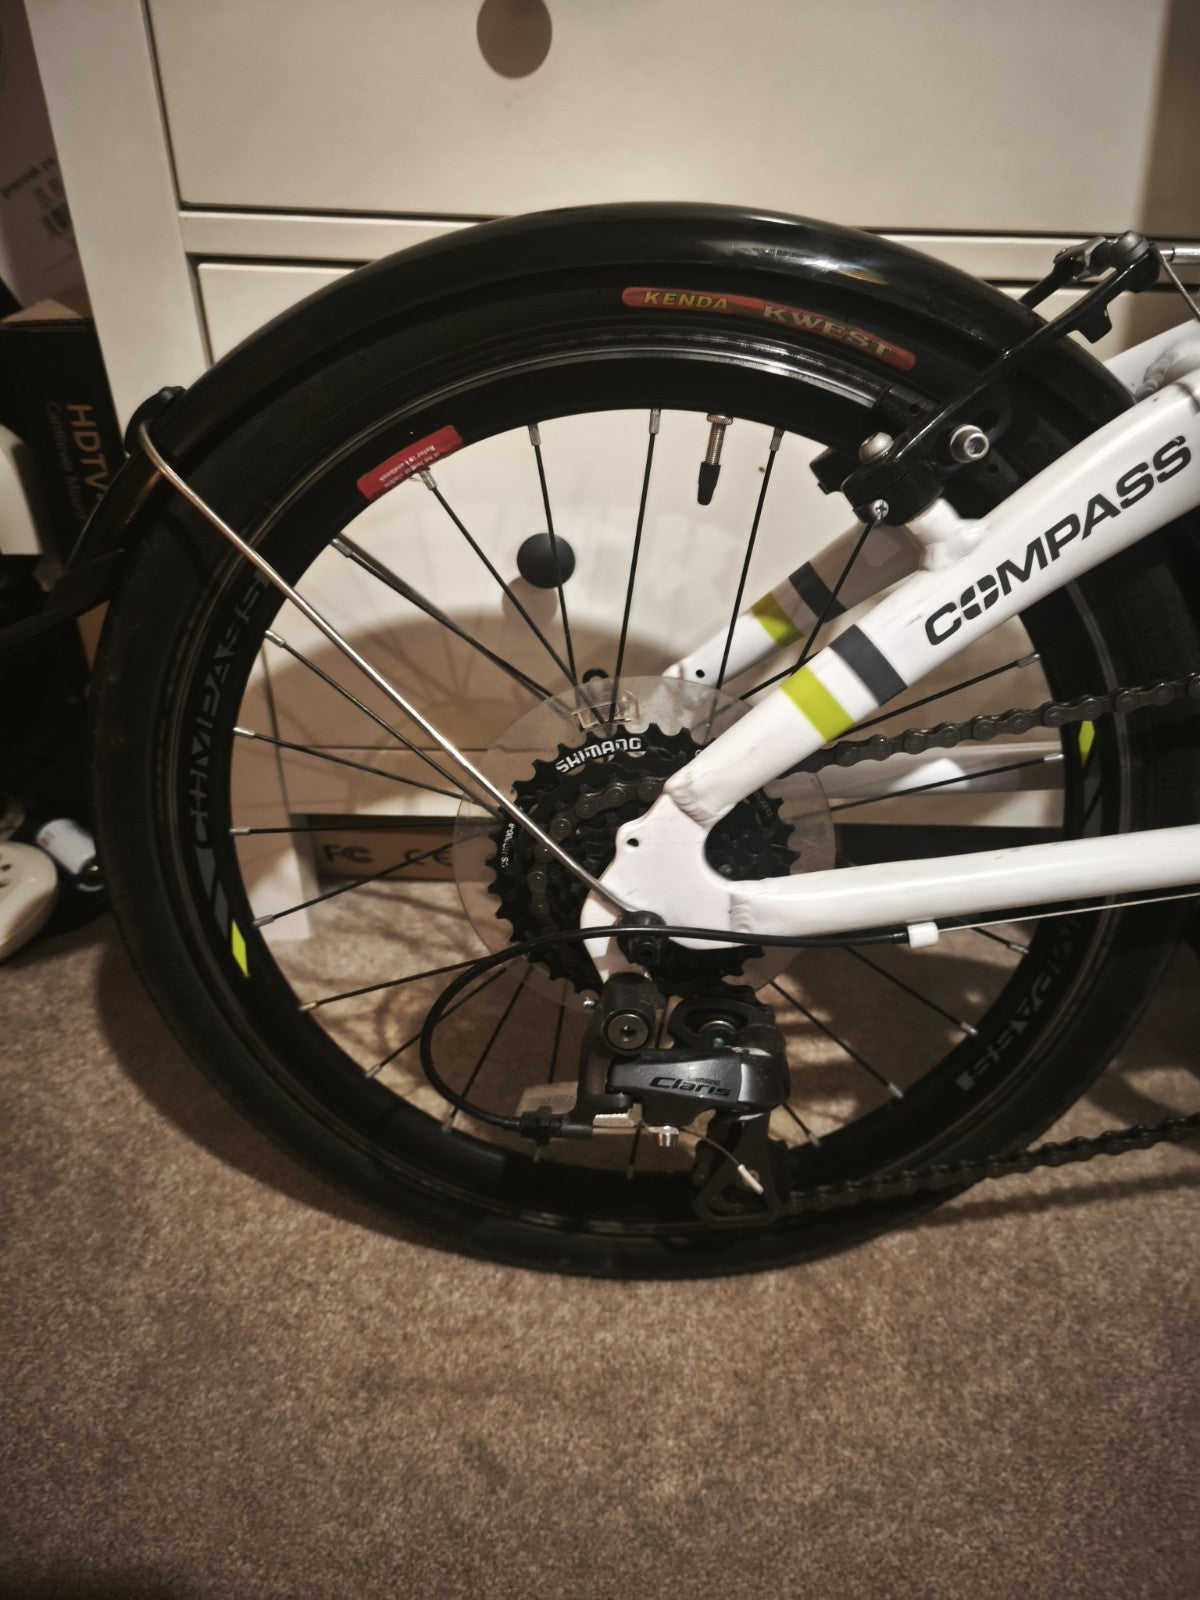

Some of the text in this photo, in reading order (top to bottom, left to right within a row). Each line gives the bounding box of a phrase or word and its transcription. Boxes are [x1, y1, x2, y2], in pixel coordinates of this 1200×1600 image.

[643, 290, 892, 357] KENDA KWEST
[66, 403, 108, 491] HDTV
[925, 435, 1192, 646] COMPASS
[555, 737, 642, 773] SHIMANO
[650, 1076, 732, 1097] Claris
